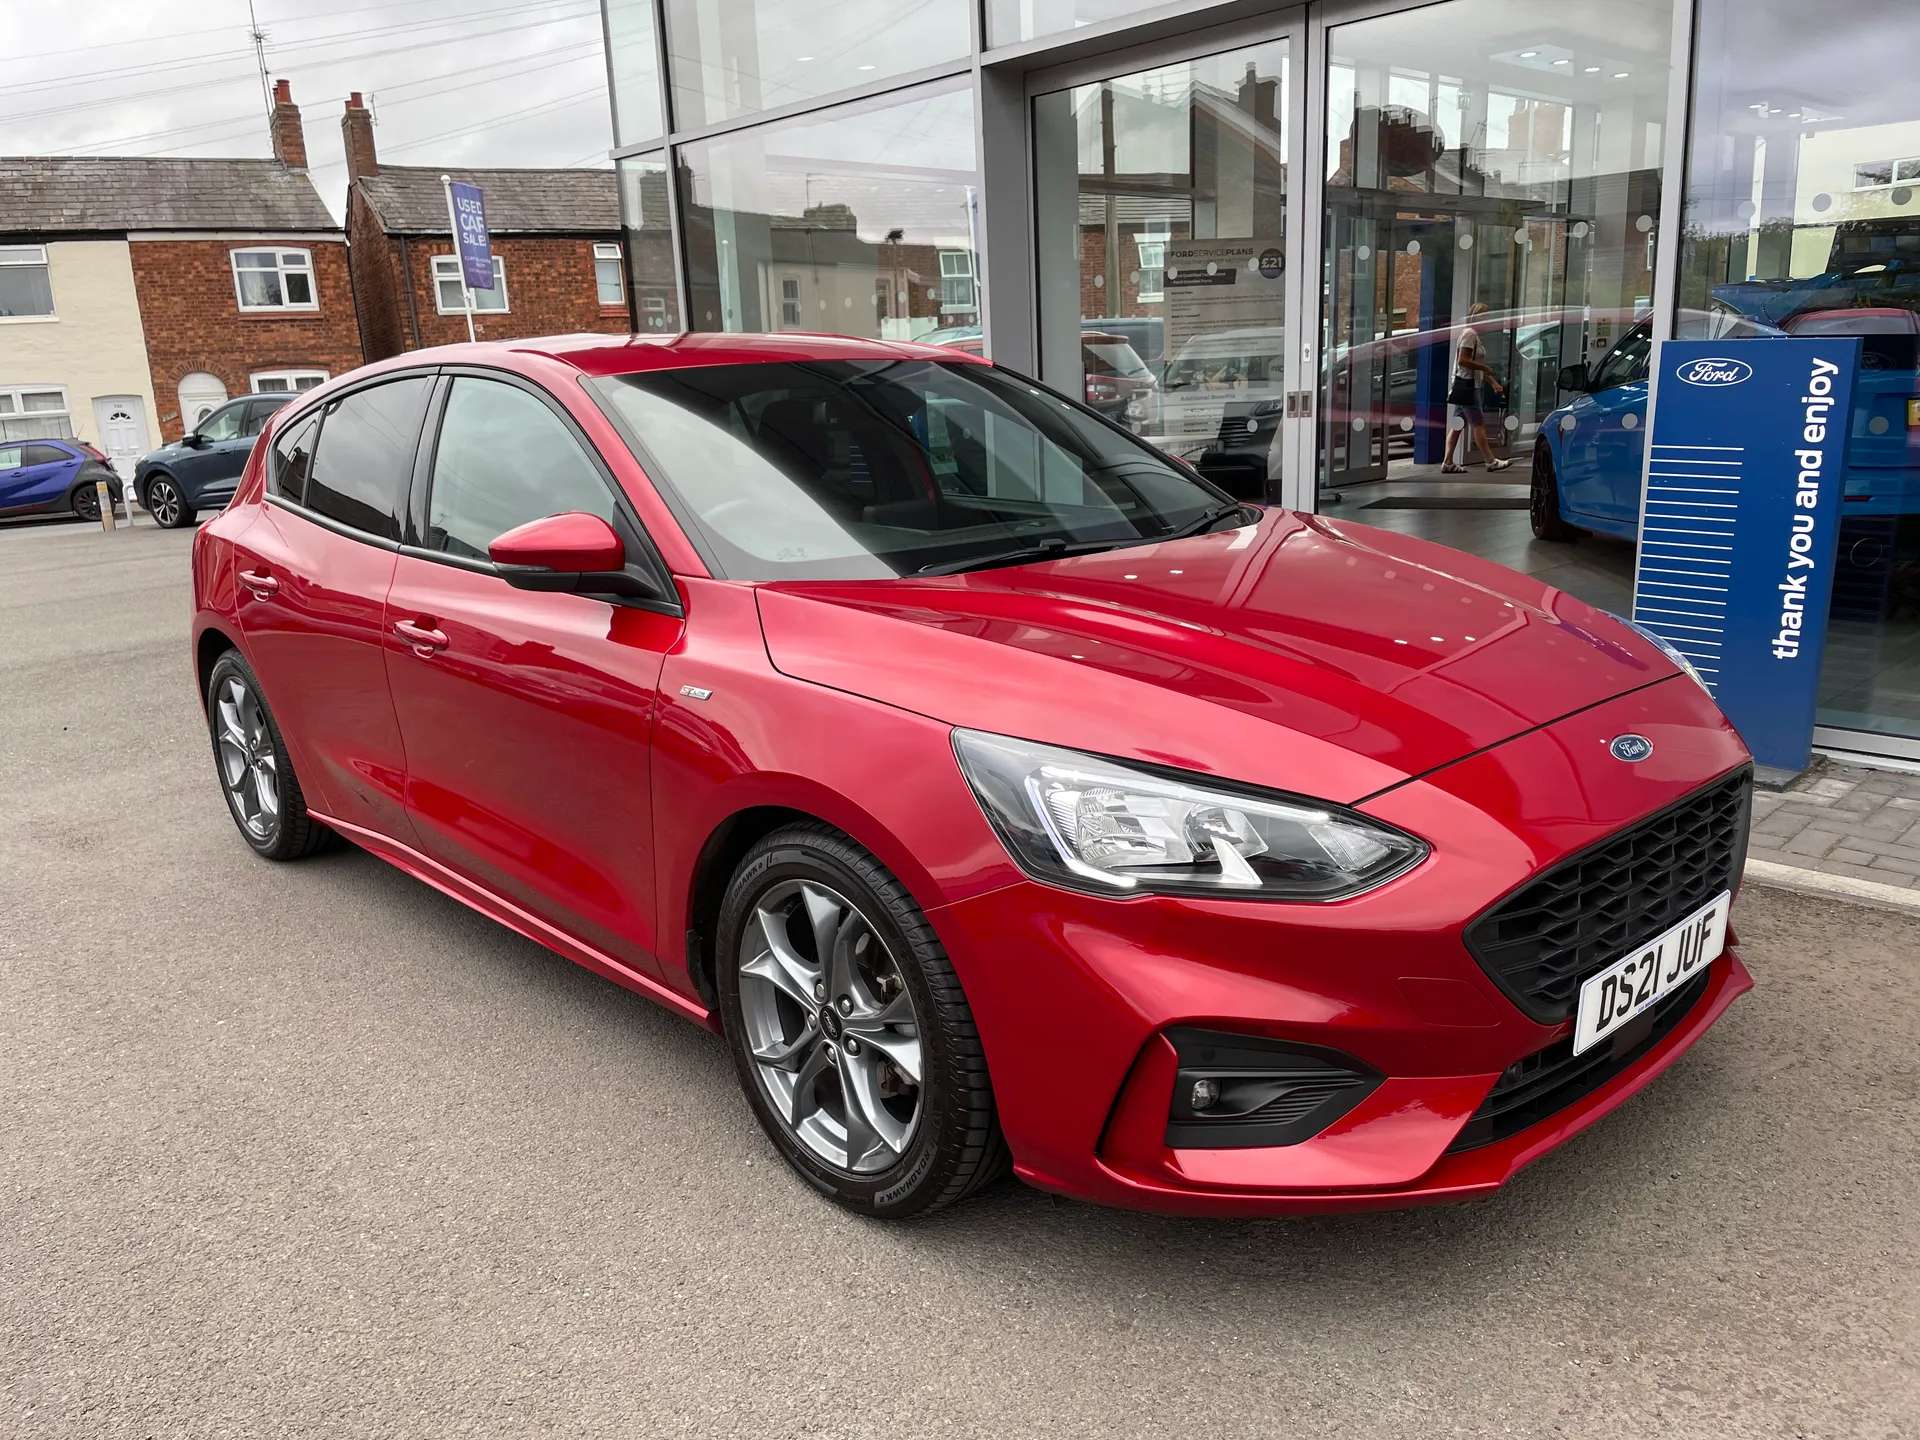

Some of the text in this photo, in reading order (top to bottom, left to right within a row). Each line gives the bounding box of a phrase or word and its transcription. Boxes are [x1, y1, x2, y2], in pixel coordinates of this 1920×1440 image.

[457, 197, 482, 214] USED
[460, 214, 485, 233] CAR
[463, 232, 487, 247] SALE
[1261, 257, 1282, 269] £21
[1687, 360, 1741, 383] Ford
[1772, 357, 1839, 659] thank you and enjoy
[1617, 739, 1646, 758] Ford
[1596, 908, 1717, 1033] DS21 JUF
